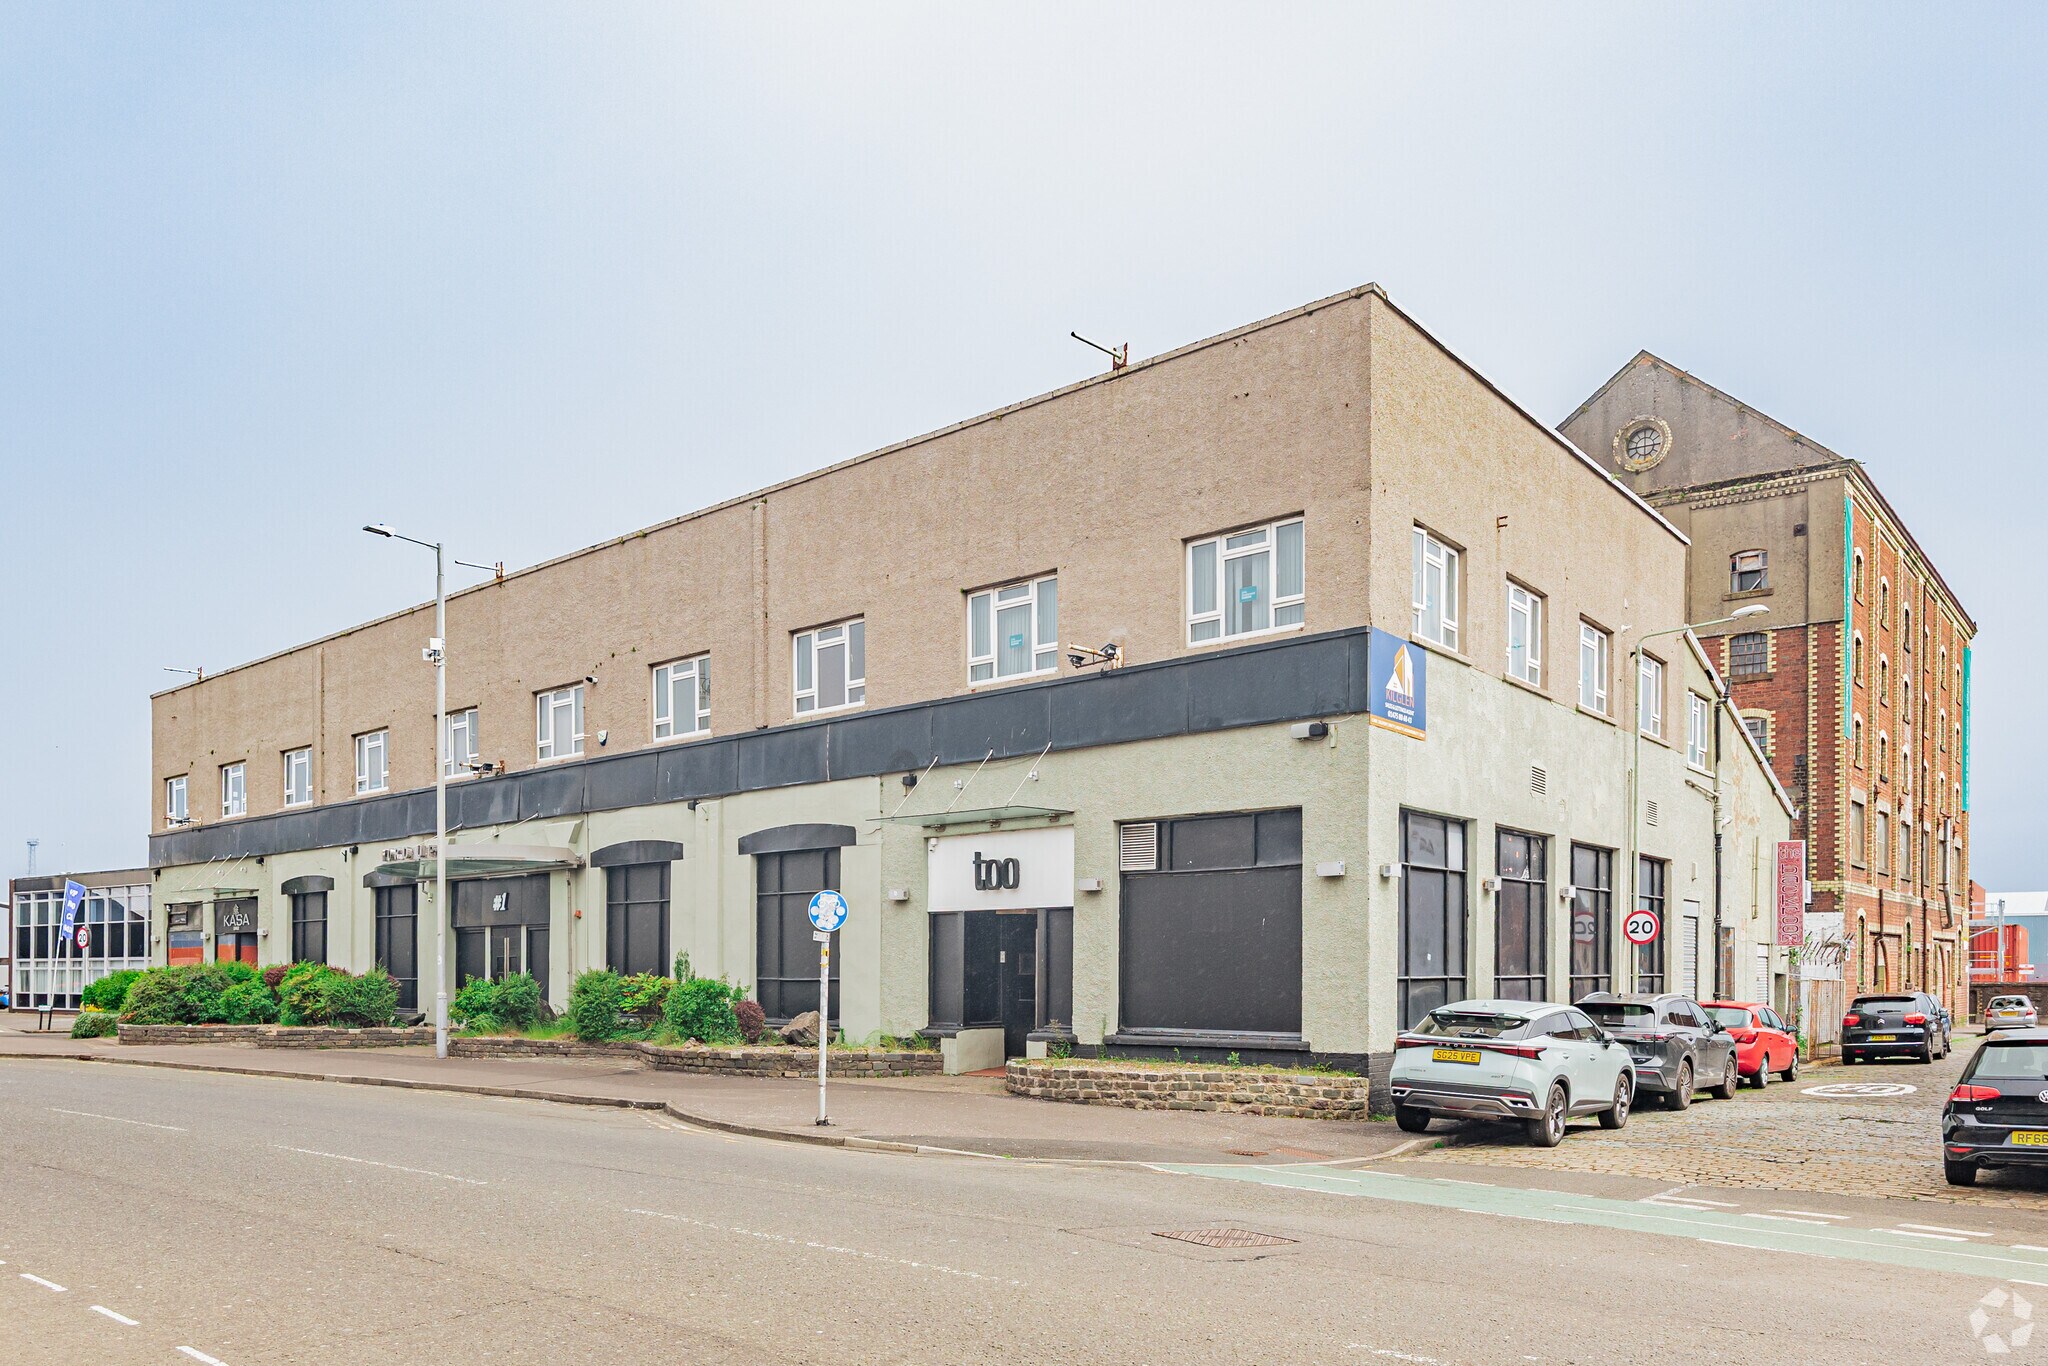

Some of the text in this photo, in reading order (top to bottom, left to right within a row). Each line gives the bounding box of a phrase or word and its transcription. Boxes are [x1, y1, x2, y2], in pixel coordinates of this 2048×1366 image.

[972, 851, 1020, 891] too
[492, 892, 509, 911] #1
[223, 913, 250, 927] KASA
[1629, 920, 1654, 935] 20
[78, 933, 87, 943] 20
[1436, 1050, 1477, 1062] SG25 VPE
[2017, 1133, 2048, 1144] RF66
